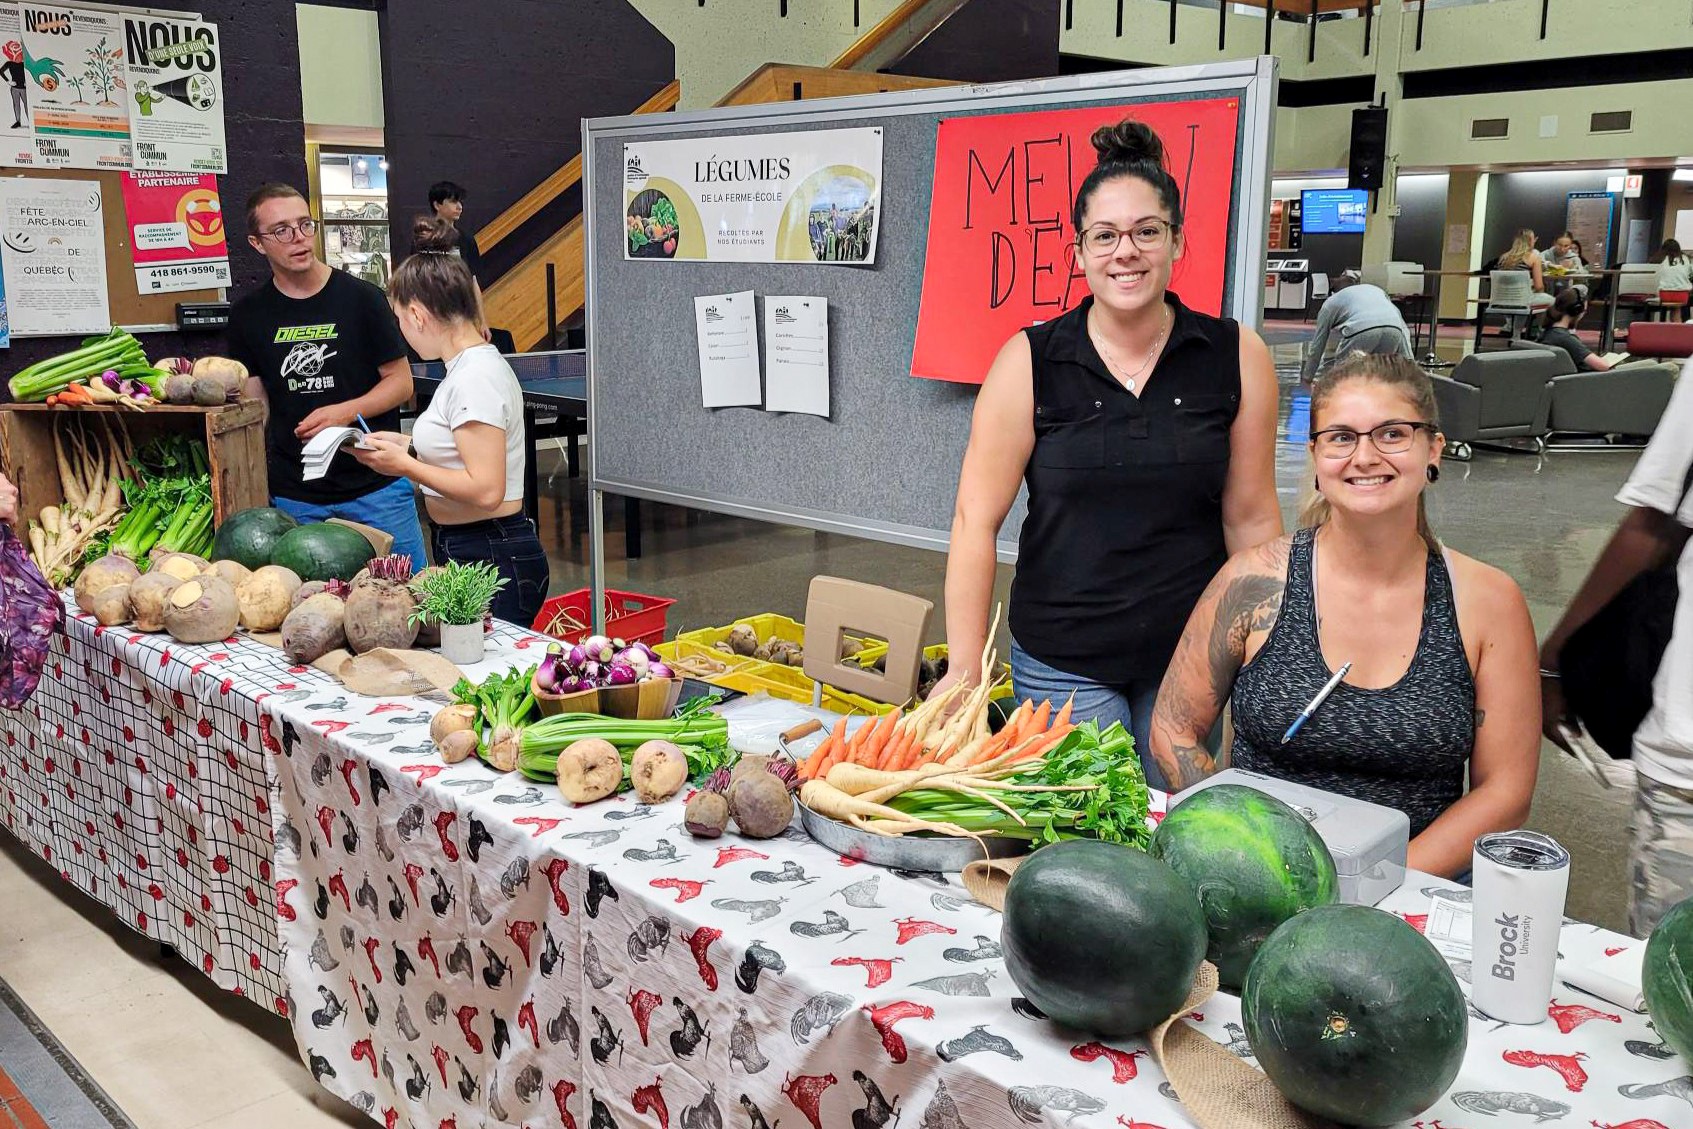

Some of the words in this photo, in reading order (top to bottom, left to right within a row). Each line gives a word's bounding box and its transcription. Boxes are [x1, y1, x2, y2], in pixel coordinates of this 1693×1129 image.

[25, 9, 72, 36] NOUS
[125, 19, 216, 72] NOUS
[36, 139, 56, 148] FRONT
[137, 142, 156, 151] FRONT
[40, 147, 70, 157] COMMUN
[140, 151, 167, 160] COMMUN
[694, 154, 790, 183] LÉGUMES
[138, 177, 200, 188] PARTENAIRE
[701, 193, 712, 202] DE
[714, 192, 723, 202] LA
[725, 191, 782, 202] FERME-ÉCOLE
[20, 206, 45, 216] FÊTE
[27, 218, 88, 227] ARC-EN-CIEL
[68, 248, 80, 256] DE
[151, 269, 169, 278] 418
[171, 265, 215, 276] 861-9590
[990, 222, 1087, 312] D'EA
[274, 323, 338, 343] DIESEL
[1520, 913, 1533, 955] University
[1491, 911, 1520, 982] Brock
